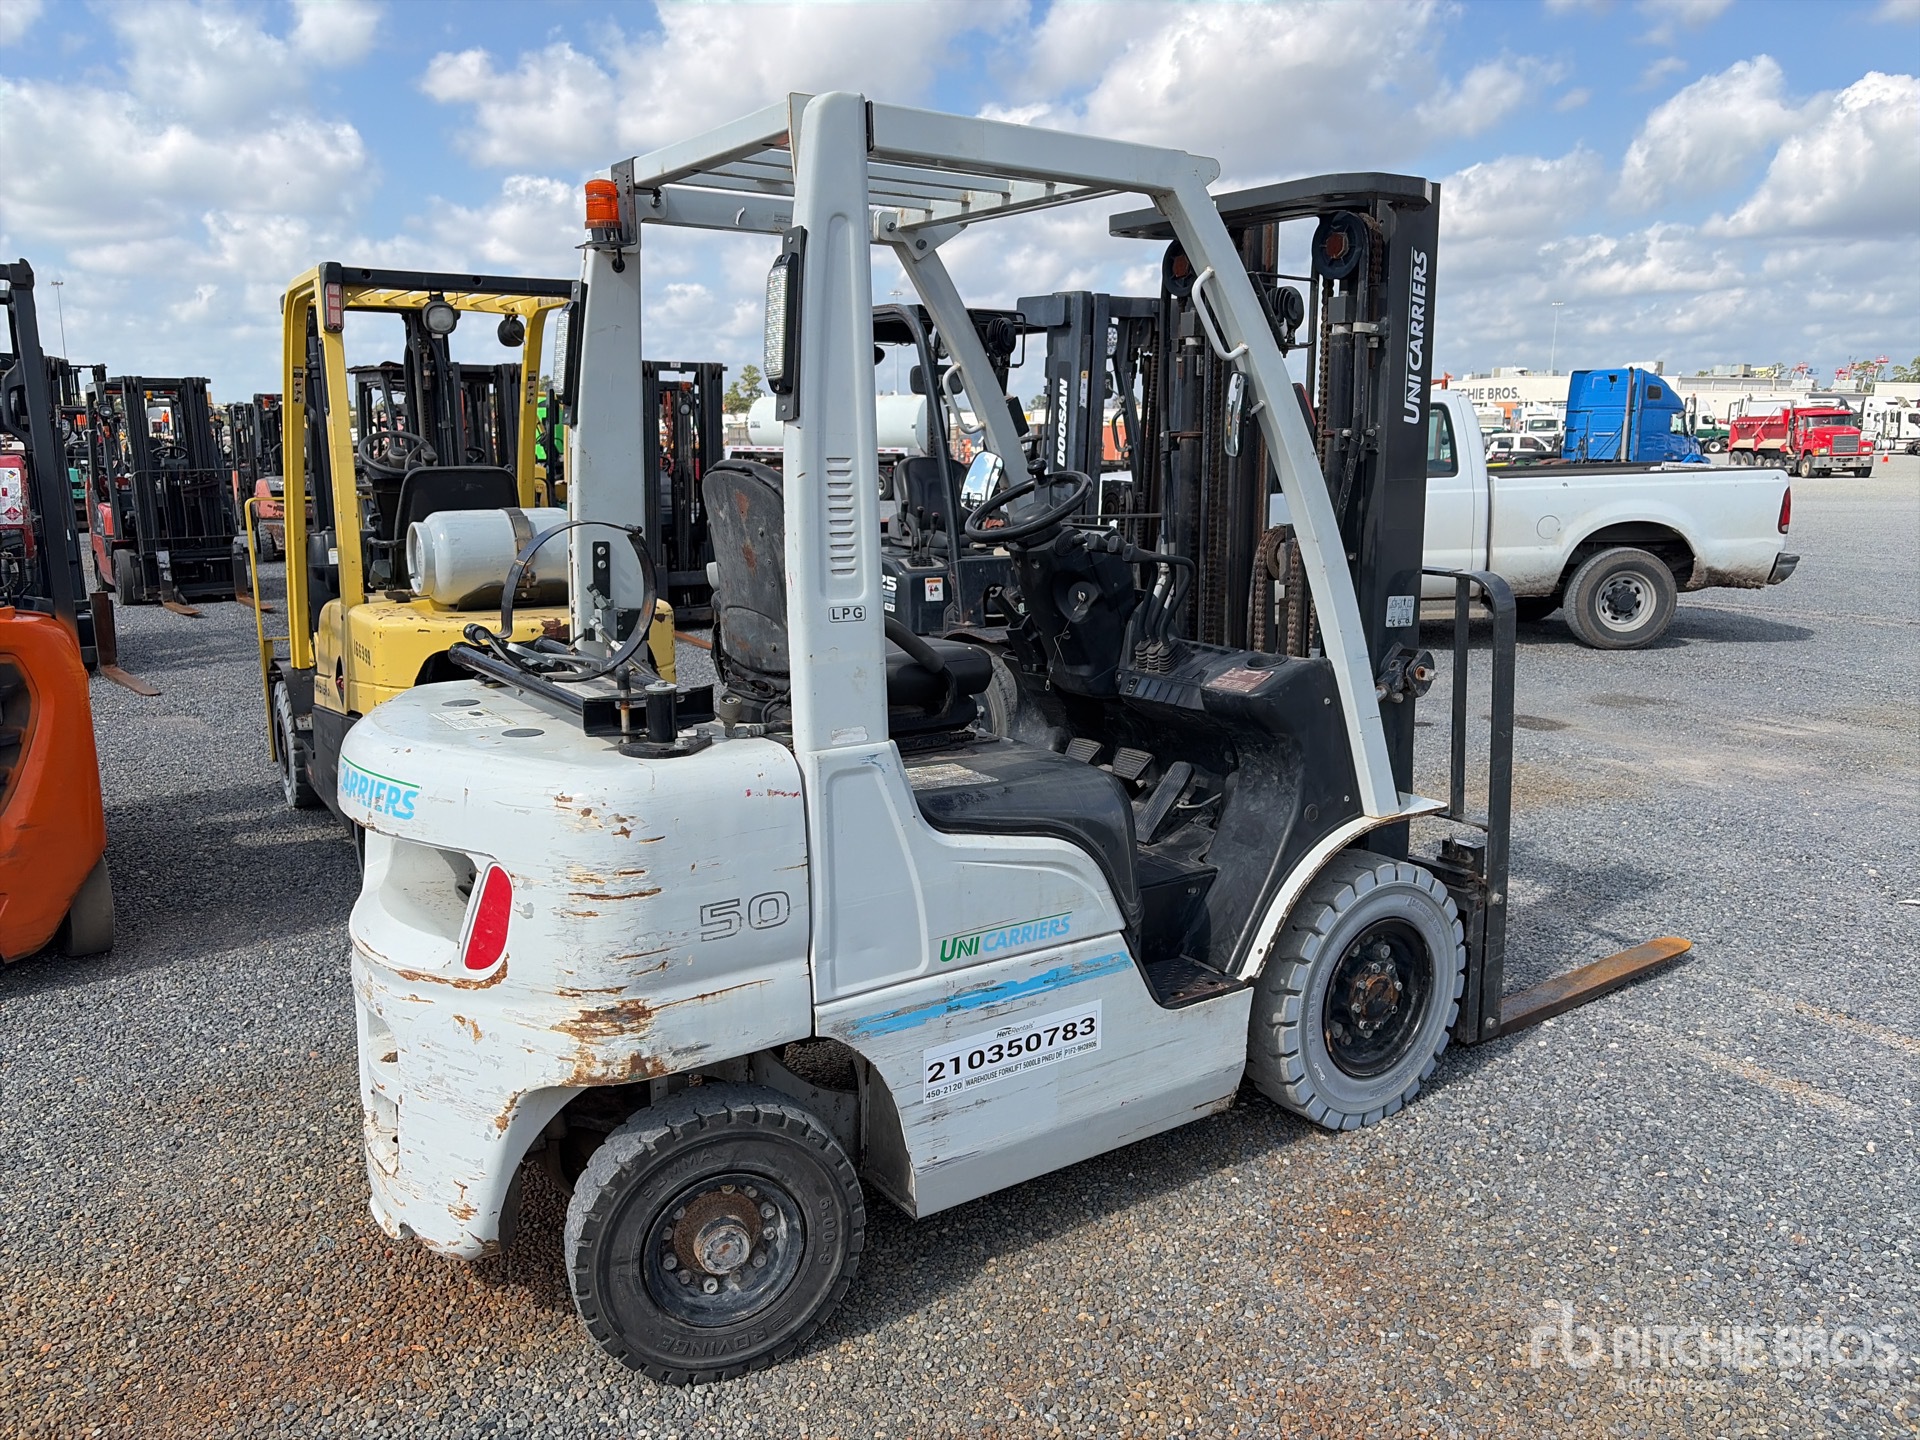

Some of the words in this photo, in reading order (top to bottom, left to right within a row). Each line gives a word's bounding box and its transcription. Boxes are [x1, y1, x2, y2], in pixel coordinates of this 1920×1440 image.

[1487, 387, 1520, 400] BROS.
[1056, 377, 1068, 468] DOOSAN
[831, 607, 863, 620] LPG
[699, 890, 791, 942] 50
[927, 1016, 1096, 1084] 210350783
[925, 1081, 963, 1099] 450-2120
[965, 1070, 998, 1087] WAREHOUSE
[998, 1062, 1023, 1077] FORKLIFT
[1023, 1057, 1041, 1069] 5000LB
[1041, 1053, 1056, 1064] PNEU
